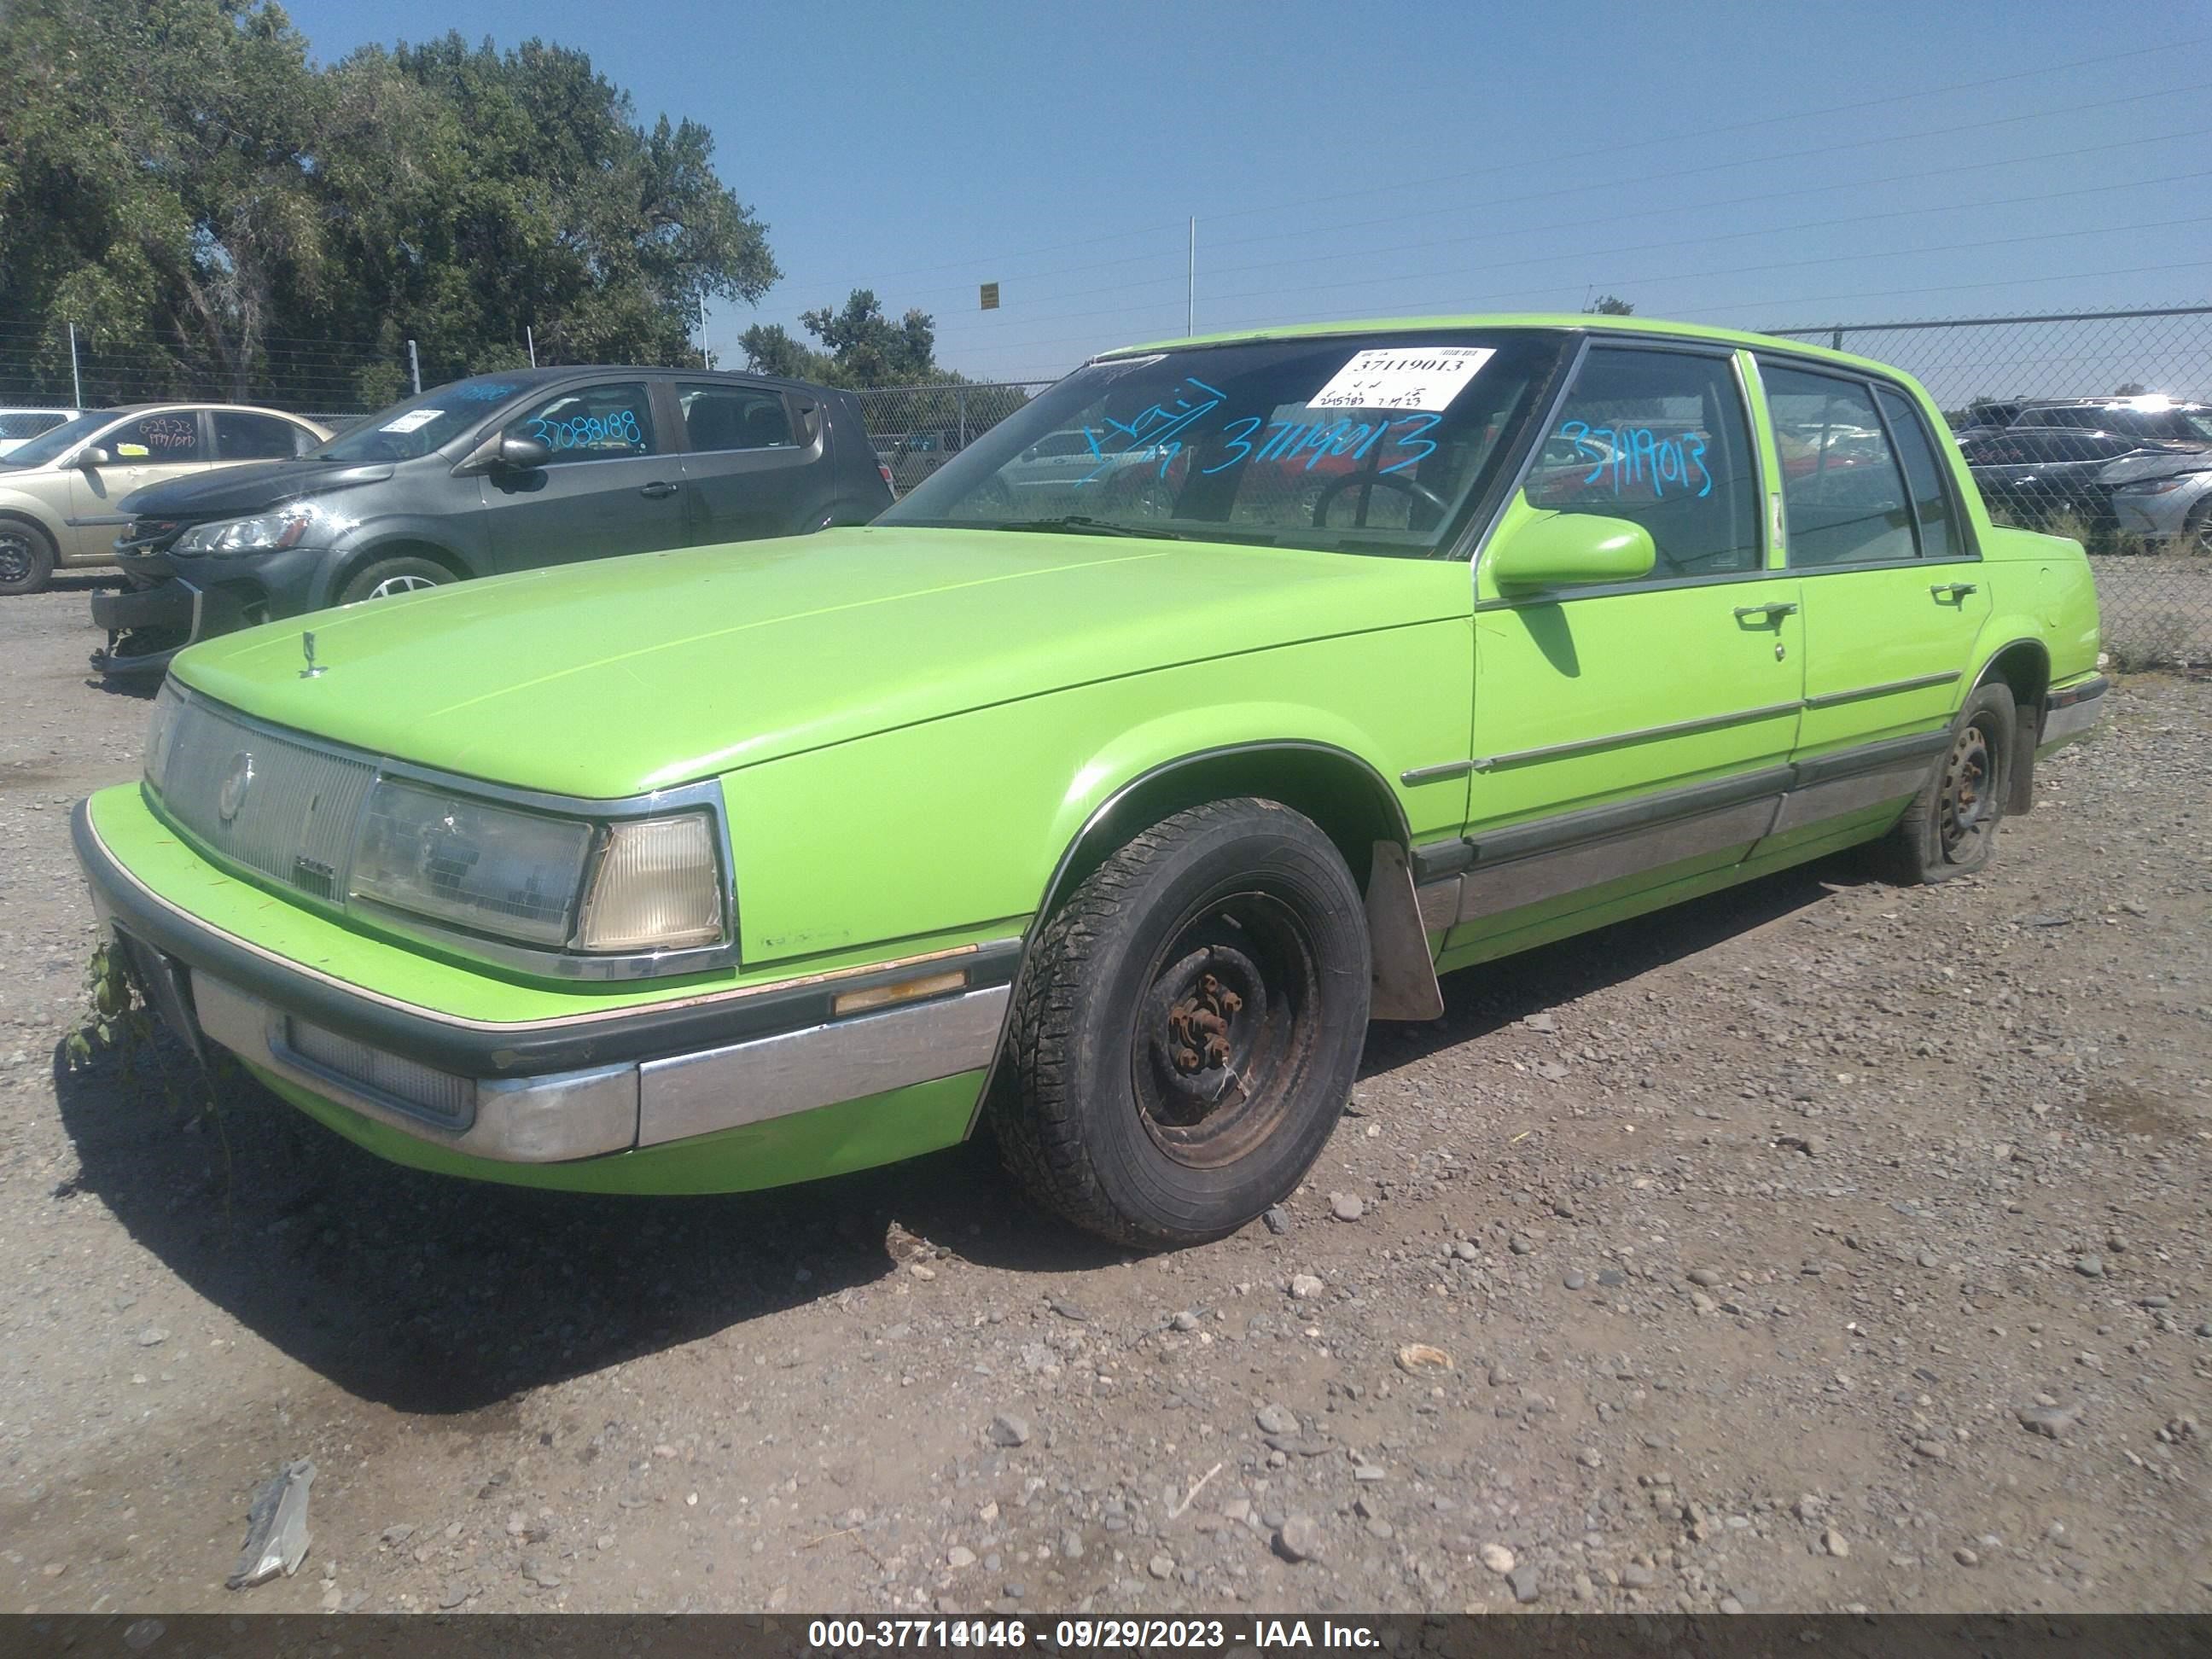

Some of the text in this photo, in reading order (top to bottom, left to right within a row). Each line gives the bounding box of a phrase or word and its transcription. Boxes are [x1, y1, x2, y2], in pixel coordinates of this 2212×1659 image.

[1353, 359, 1464, 371] 37119013
[527, 410, 640, 448] 37088188
[1202, 414, 1442, 474] 37119013
[1561, 421, 1712, 497] 37119013
